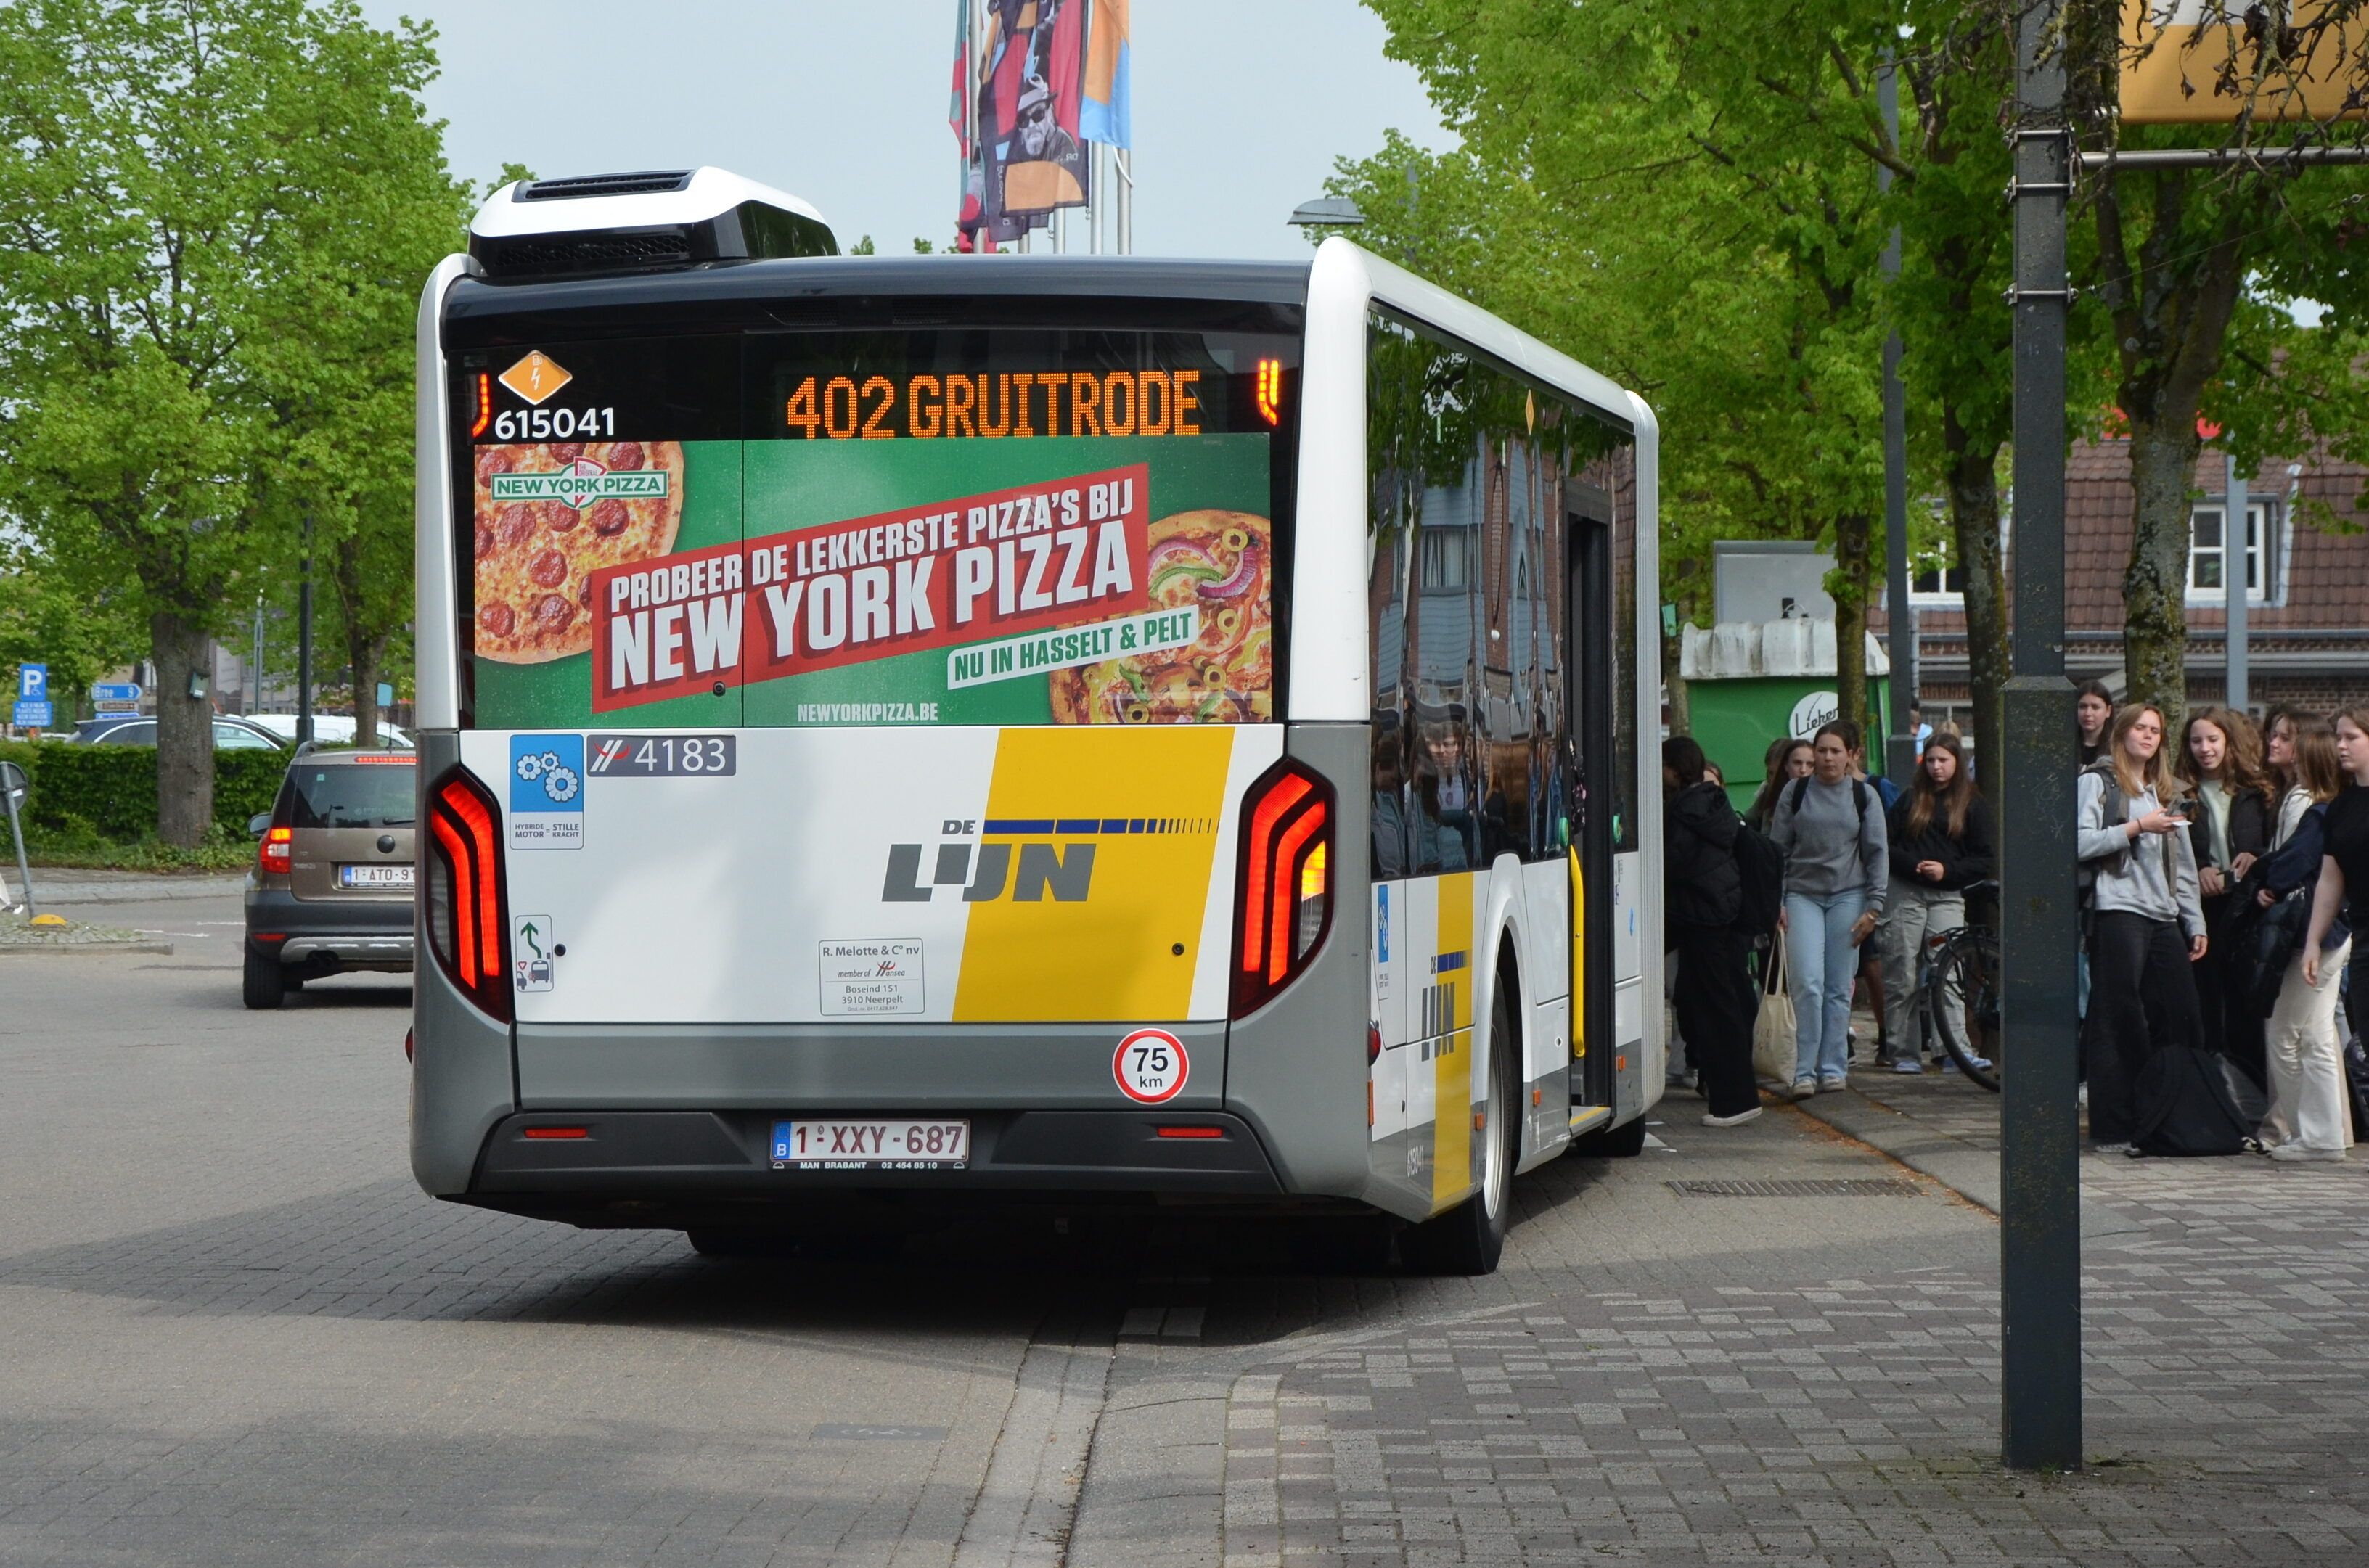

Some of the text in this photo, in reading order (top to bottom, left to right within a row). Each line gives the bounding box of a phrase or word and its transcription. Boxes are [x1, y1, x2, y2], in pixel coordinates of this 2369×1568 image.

[787, 370, 1200, 440] 402 GRUITRODE
[495, 408, 614, 440] 615041
[497, 477, 660, 494] NEW YORK PIZZA
[611, 477, 1133, 612] PROBEER DE LEKKERSTE PIZZA'S BIJ
[611, 520, 1133, 690] NEW YORK PIZZA
[955, 612, 1192, 681] NU IN HASSELT & PELT
[23, 670, 42, 696] P
[128, 686, 135, 698] 9
[798, 702, 938, 722] NEWYORKPIZZA.BE
[634, 739, 726, 772] 4183
[942, 819, 976, 834] DE
[881, 843, 1097, 902] LIJN
[823, 947, 833, 956] R.
[835, 946, 879, 956] Melotte
[881, 945, 889, 955] &
[838, 969, 863, 978] member
[864, 969, 872, 977] of
[846, 984, 898, 993] Boseind 151
[842, 995, 903, 1005] 3910 Neerpelt
[1132, 1048, 1169, 1073] 75
[1139, 1075, 1163, 1088] km
[777, 1144, 787, 1156] B
[796, 1125, 963, 1154] 1-XXY-687
